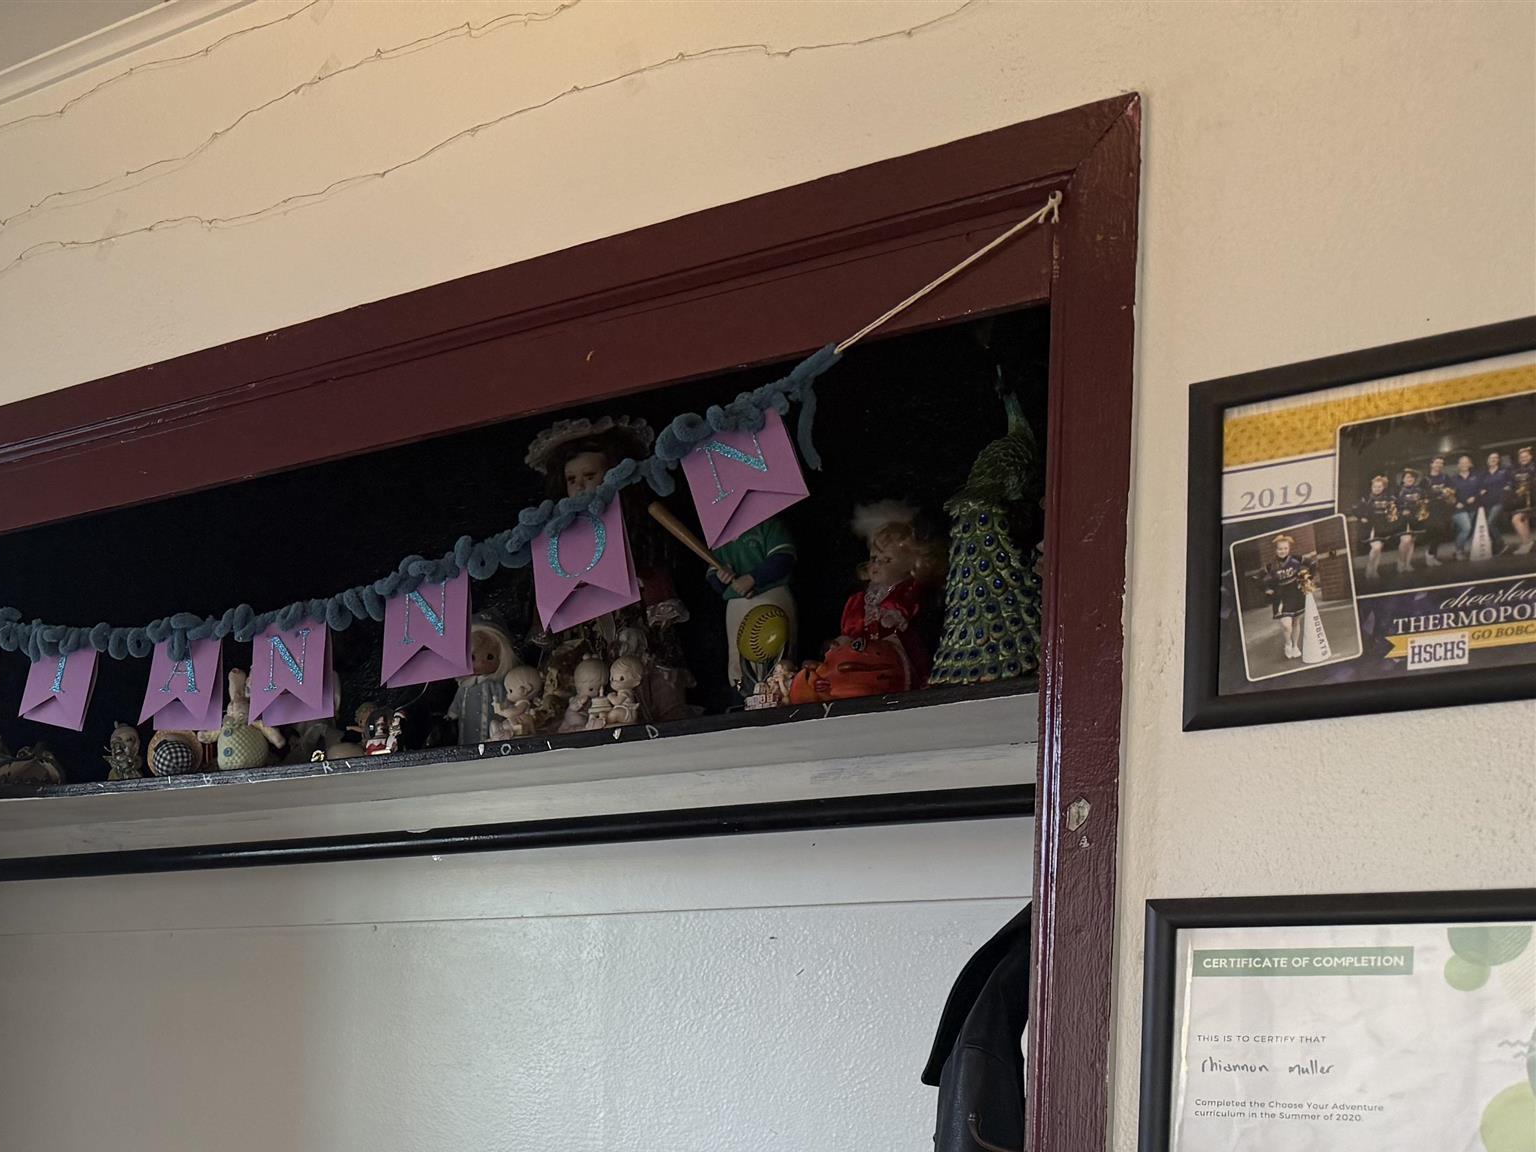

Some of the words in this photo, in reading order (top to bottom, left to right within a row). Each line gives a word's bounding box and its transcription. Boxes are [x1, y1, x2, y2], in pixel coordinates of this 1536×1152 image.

[1240, 482, 1312, 512] 2019
[1393, 602, 1536, 634] THERMOPO
[1471, 628, 1492, 641] GO
[1494, 623, 1536, 639] BOBC
[1410, 640, 1466, 665] HSCHS
[1202, 957, 1287, 969] CERTIFICATE
[1291, 957, 1309, 968] OF
[1313, 955, 1404, 968] COMPLETION
[1197, 1034, 1219, 1043] THIS
[1223, 1034, 1232, 1043] IS
[1237, 1035, 1250, 1043] TO
[1253, 1035, 1295, 1043] CERTIFY
[1195, 1098, 1246, 1109] Completed
[1249, 1100, 1265, 1108] the
[1268, 1101, 1303, 1109] Choose
[1306, 1102, 1329, 1110] Your
[1331, 1103, 1384, 1111] Adventure
[1195, 1109, 1245, 1118] curriculum
[1249, 1110, 1257, 1118] in
[1260, 1111, 1276, 1119] the
[1279, 1112, 1320, 1120] Summer
[1323, 1112, 1333, 1120] of
